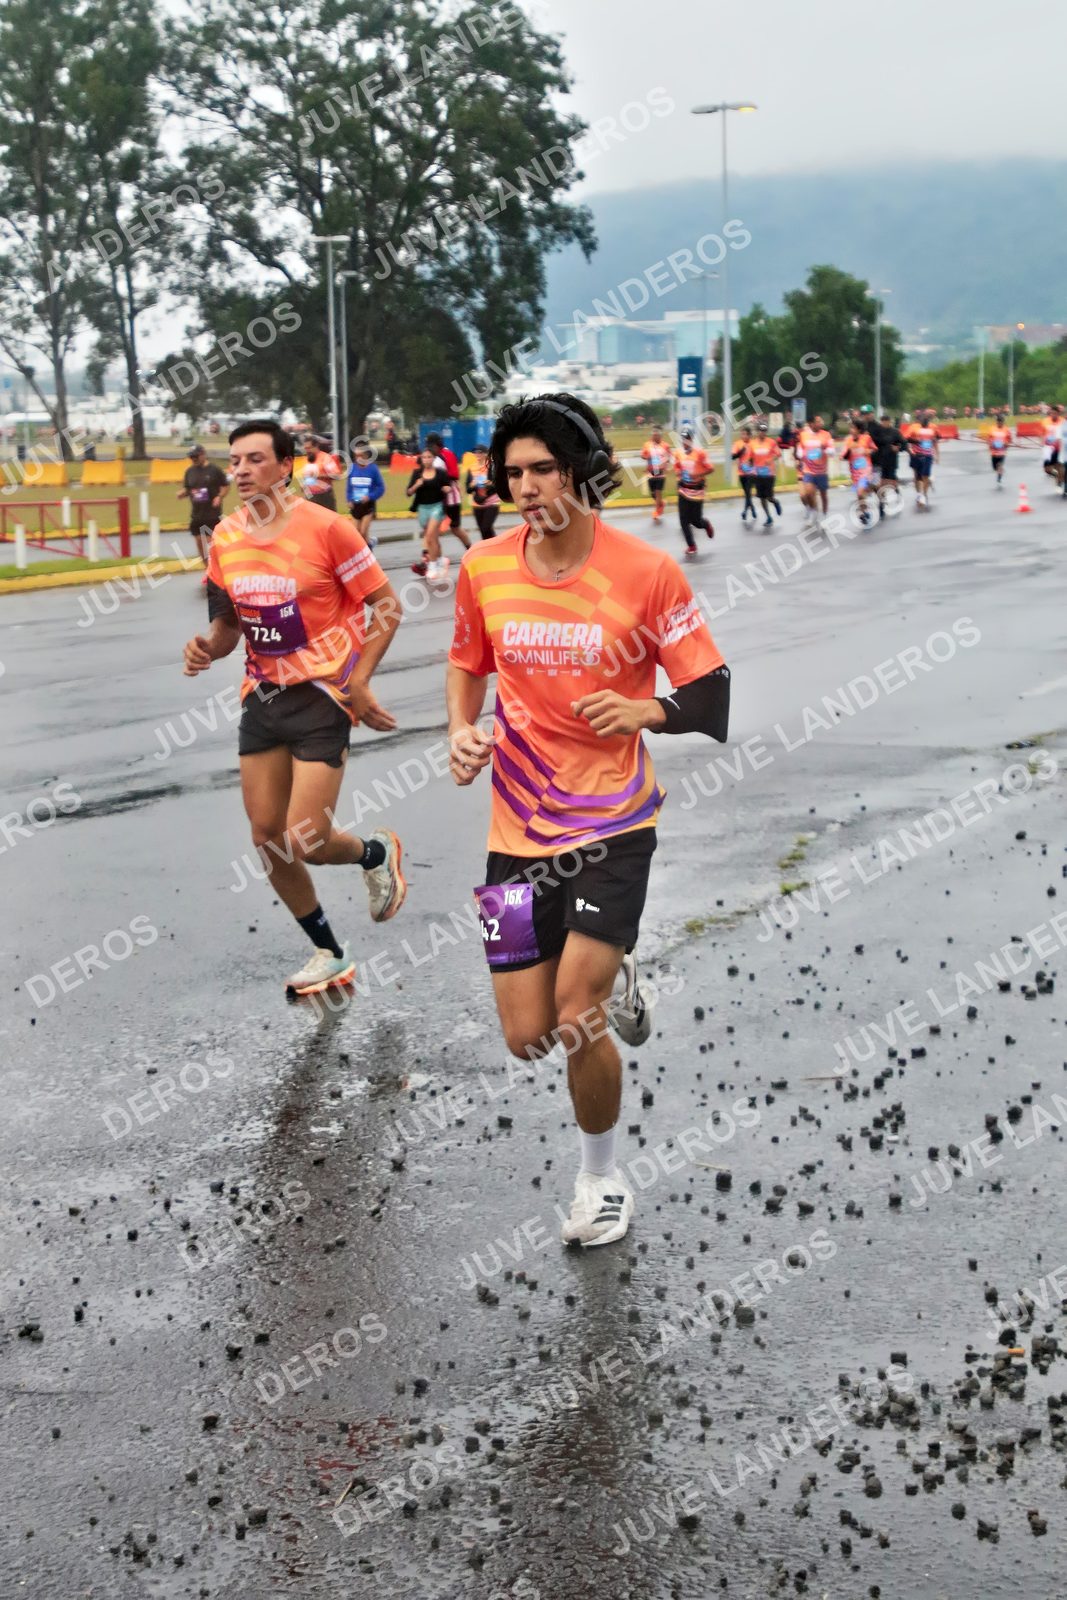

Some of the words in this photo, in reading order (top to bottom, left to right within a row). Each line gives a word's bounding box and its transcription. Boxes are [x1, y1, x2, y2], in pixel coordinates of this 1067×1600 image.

[681, 373, 697, 392] E
[233, 575, 297, 597] CARRERA
[280, 605, 295, 618] 16K
[251, 626, 282, 641] 724
[502, 620, 603, 647] CARRERA
[503, 649, 580, 665] OMNILIFE
[504, 889, 525, 905] 16K
